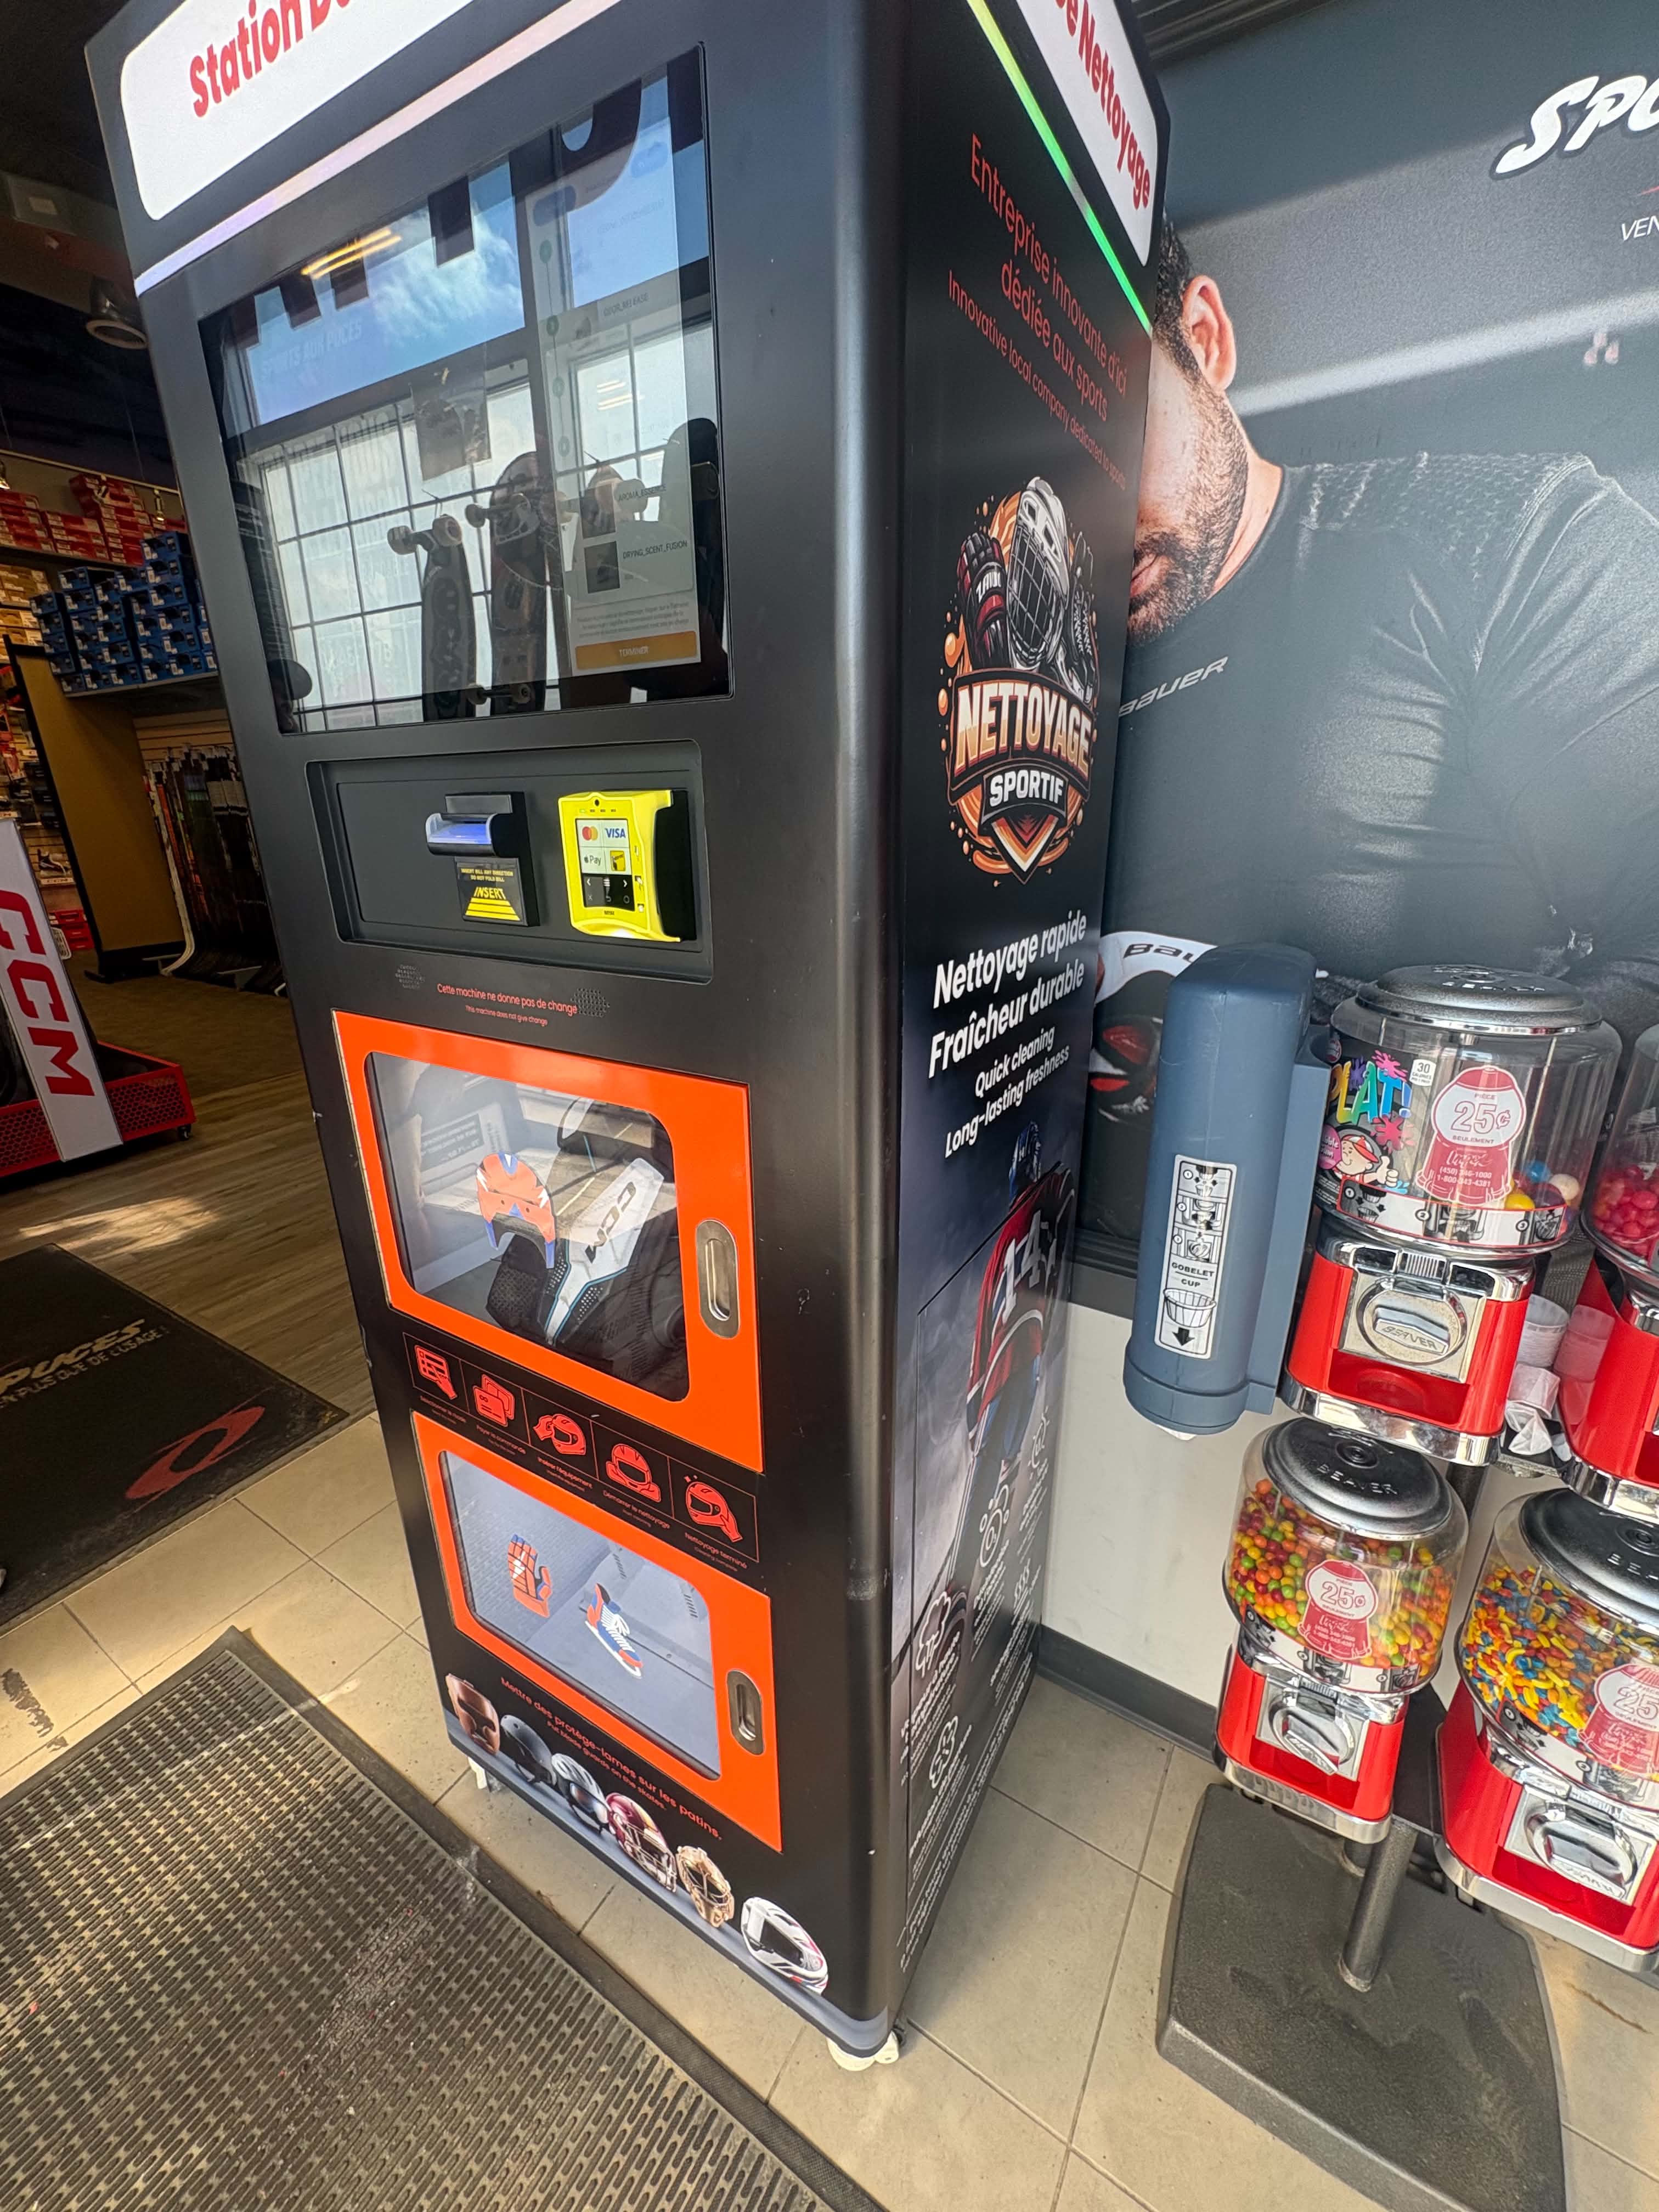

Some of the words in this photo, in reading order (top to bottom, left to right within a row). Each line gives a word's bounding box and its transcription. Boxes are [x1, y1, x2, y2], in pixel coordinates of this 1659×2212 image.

[190, 0, 303, 117] Station
[1078, 0, 1150, 210] Nettoyage
[970, 133, 1050, 284] Entreprise
[1052, 267, 1107, 368] innovante
[1108, 351, 1127, 396] d'ici
[1001, 259, 1051, 348] dédiée
[1053, 332, 1075, 382] aux
[1076, 364, 1108, 422] sports
[949, 269, 1007, 357] Innovative
[1008, 340, 1032, 385] local
[1032, 374, 1070, 432] company
[1070, 416, 1103, 466] dedicated
[618, 484, 667, 501] AROMA_ESSENCE
[623, 540, 688, 559] DRYING_SCENT_FUSION
[954, 680, 1092, 778] NETTOYAGE
[990, 769, 1064, 807] SPORTIF
[605, 828, 626, 839] VISA
[589, 855, 602, 866] Pay
[473, 886, 507, 900] INSERT
[933, 933, 1039, 1009] Nettoyage
[1040, 910, 1087, 963] rapide
[0, 890, 95, 1097] CCM
[437, 983, 455, 995] Cette
[455, 988, 487, 1000] machine
[487, 992, 496, 1001] ne
[497, 993, 521, 1005] donne
[521, 997, 535, 1008] pas
[536, 998, 547, 1009] de
[548, 1000, 578, 1017] change
[465, 1005, 475, 1013] This
[928, 991, 1029, 1079] Fraîcheur
[1029, 958, 1085, 1015] durable
[974, 1054, 1011, 1098] Quick
[1011, 1026, 1056, 1072] cleaning
[1418, 1062, 1430, 1074] 30
[945, 1084, 1024, 1159] Long-lasting
[1025, 1045, 1070, 1093] freshness
[1451, 1101, 1511, 1135] 25¢
[1452, 1135, 1494, 1144] SEULEMENT
[1440, 1166, 1458, 1176] (450)
[584, 1181, 636, 1263] CCM
[1171, 1262, 1215, 1277] GOBELET
[1181, 1278, 1201, 1288] CUP
[1382, 1326, 1438, 1350] BEAVER
[87, 1351, 110, 1366] DE
[500, 1677, 533, 1705] Mettre
[534, 1700, 554, 1719] des
[639, 1774, 657, 1793] sur
[658, 1788, 678, 1808] les
[679, 1805, 723, 1841] patins.
[610, 1767, 623, 1779] on
